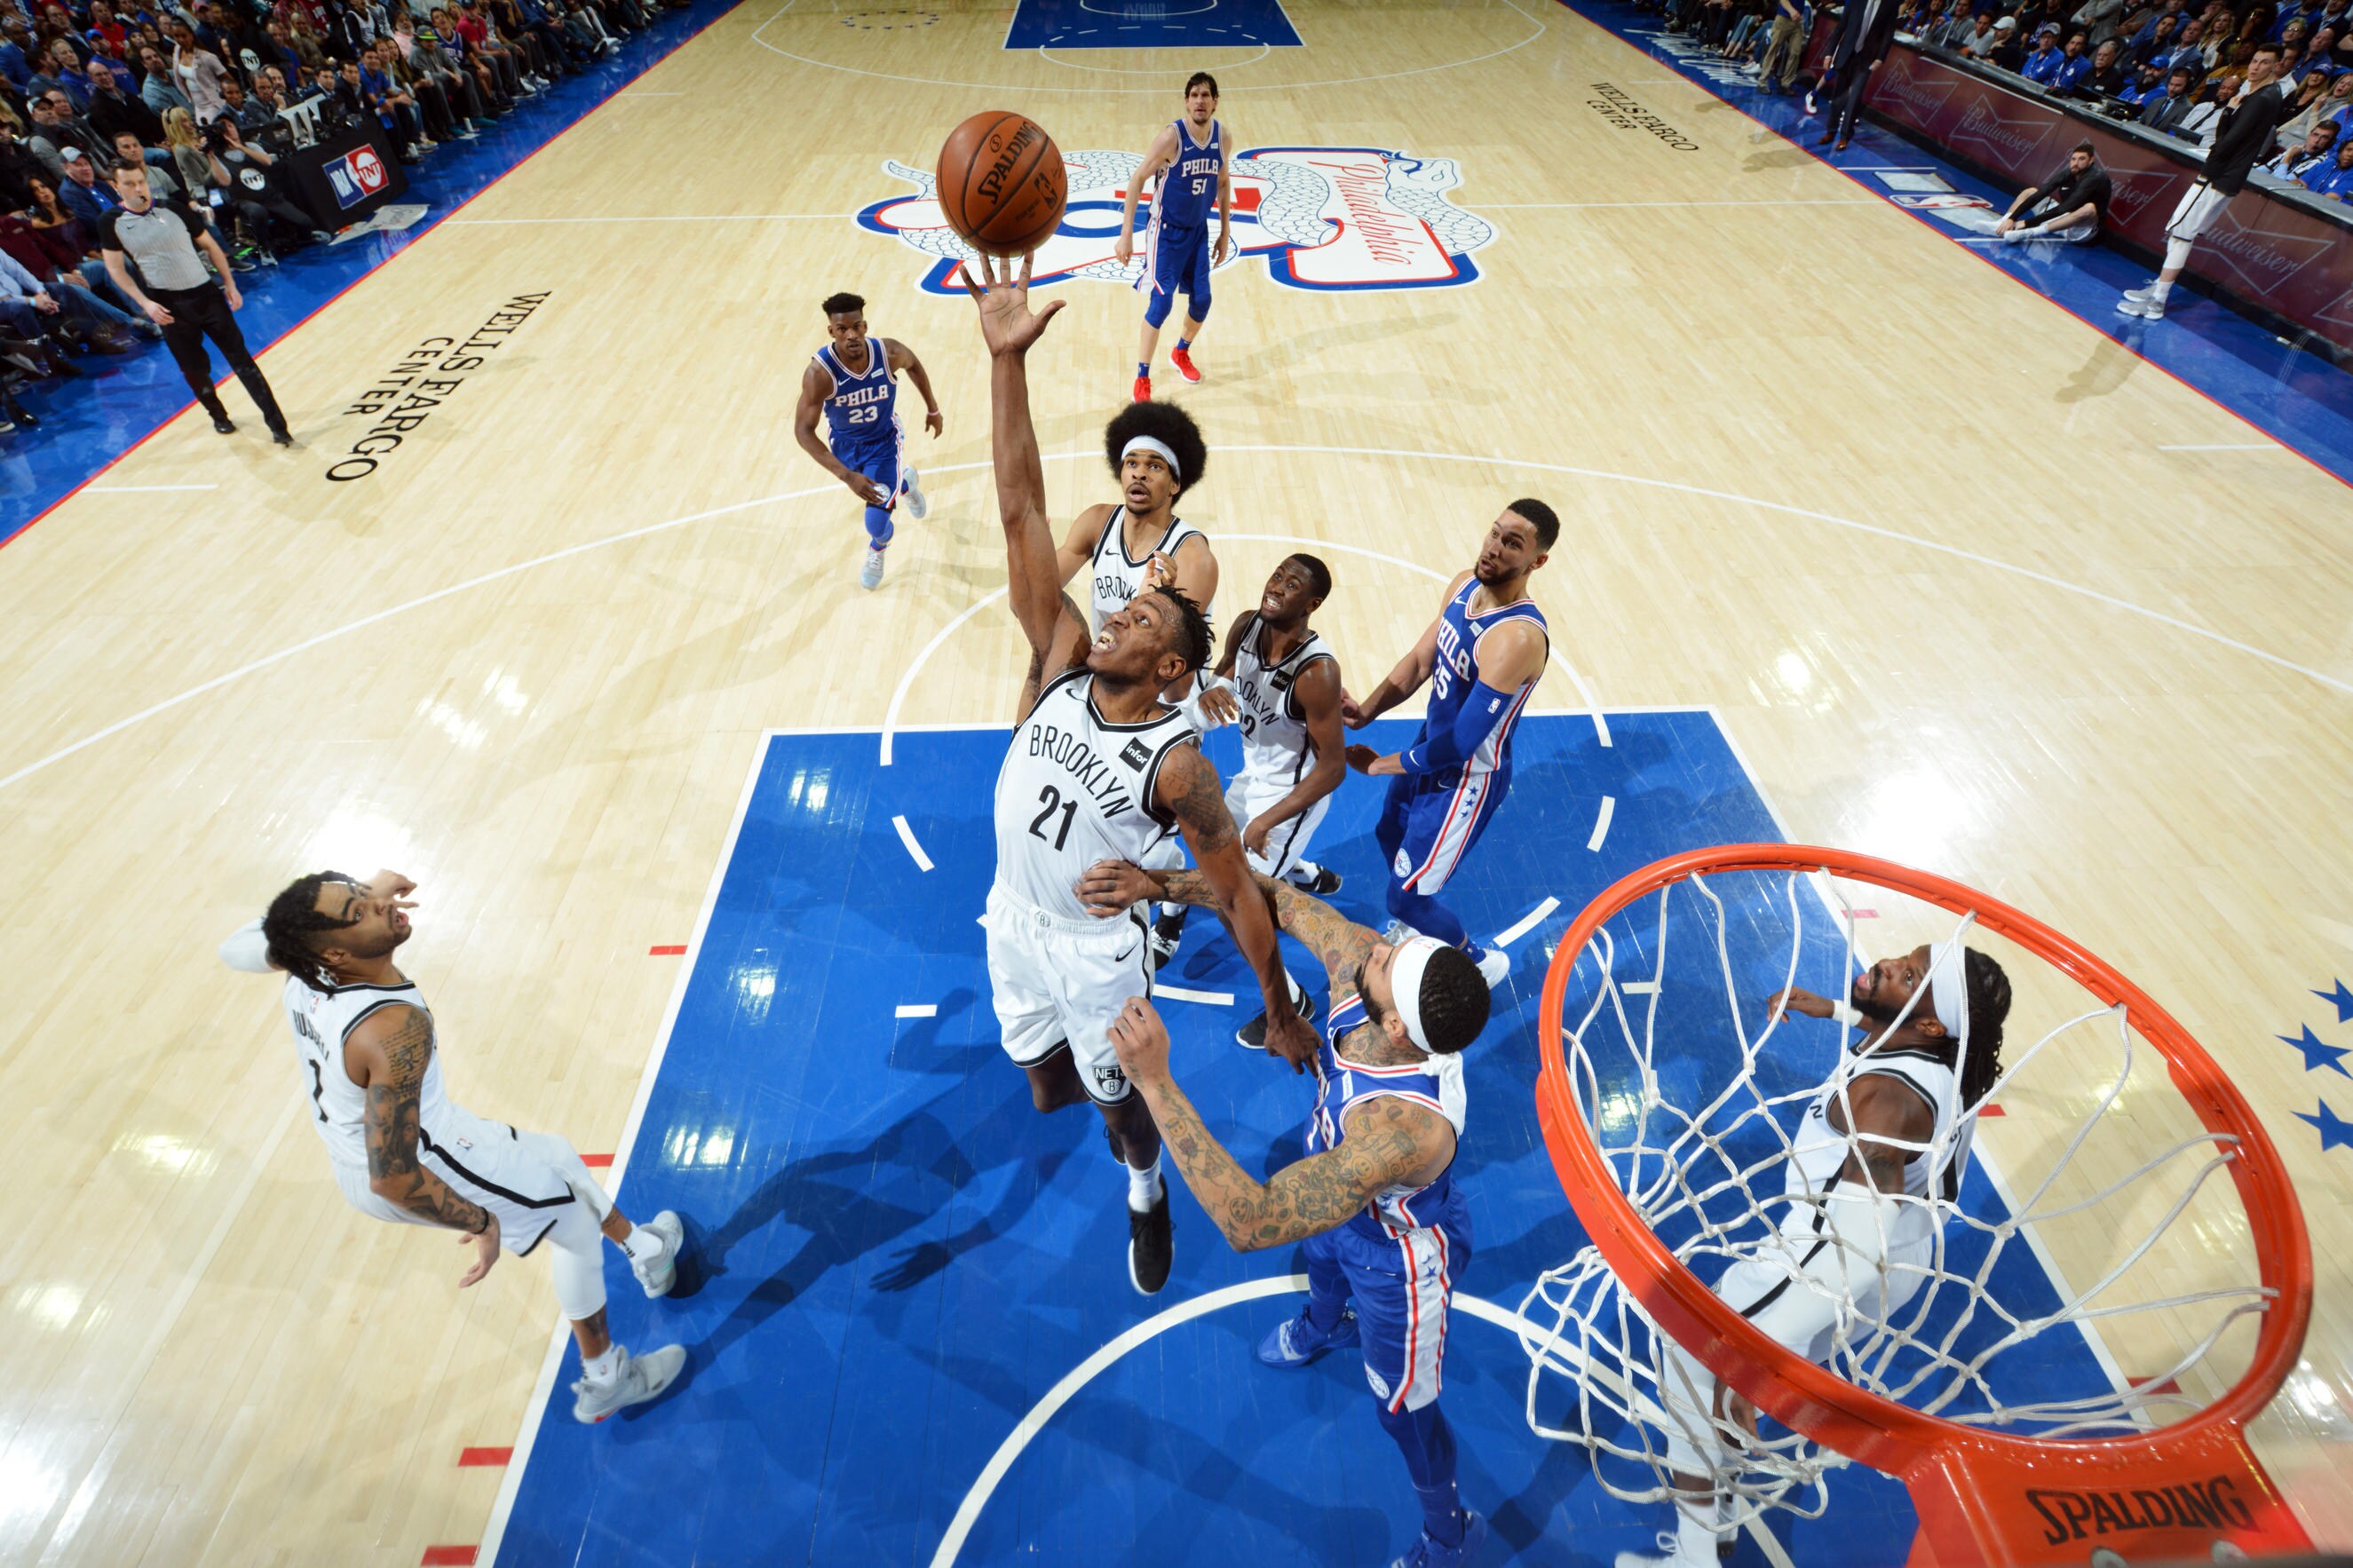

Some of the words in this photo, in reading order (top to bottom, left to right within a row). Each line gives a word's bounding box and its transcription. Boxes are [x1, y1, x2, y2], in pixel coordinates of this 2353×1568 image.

[1587, 99, 1637, 130] CENTER
[1589, 82, 1648, 114] WELLS
[1631, 115, 1699, 151] FARGO
[1965, 103, 2034, 154] Budweiser
[241, 174, 265, 185] TNT
[358, 162, 380, 181] TNT
[978, 121, 1042, 205] SPALDING
[1181, 158, 1219, 178] PHILA
[1192, 178, 1208, 195] 51
[2204, 222, 2298, 273] udweiser
[439, 290, 552, 372] WELLS
[342, 337, 455, 416] CENTER
[835, 384, 890, 408] PHILA
[325, 377, 465, 482] FARGO
[848, 406, 879, 424] 23
[1436, 616, 1471, 683] HILA
[1029, 723, 1135, 820] BROOKLYN
[1124, 743, 1149, 765] infor
[1028, 784, 1080, 852] 21
[2025, 1474, 2268, 1547] SPALDING
